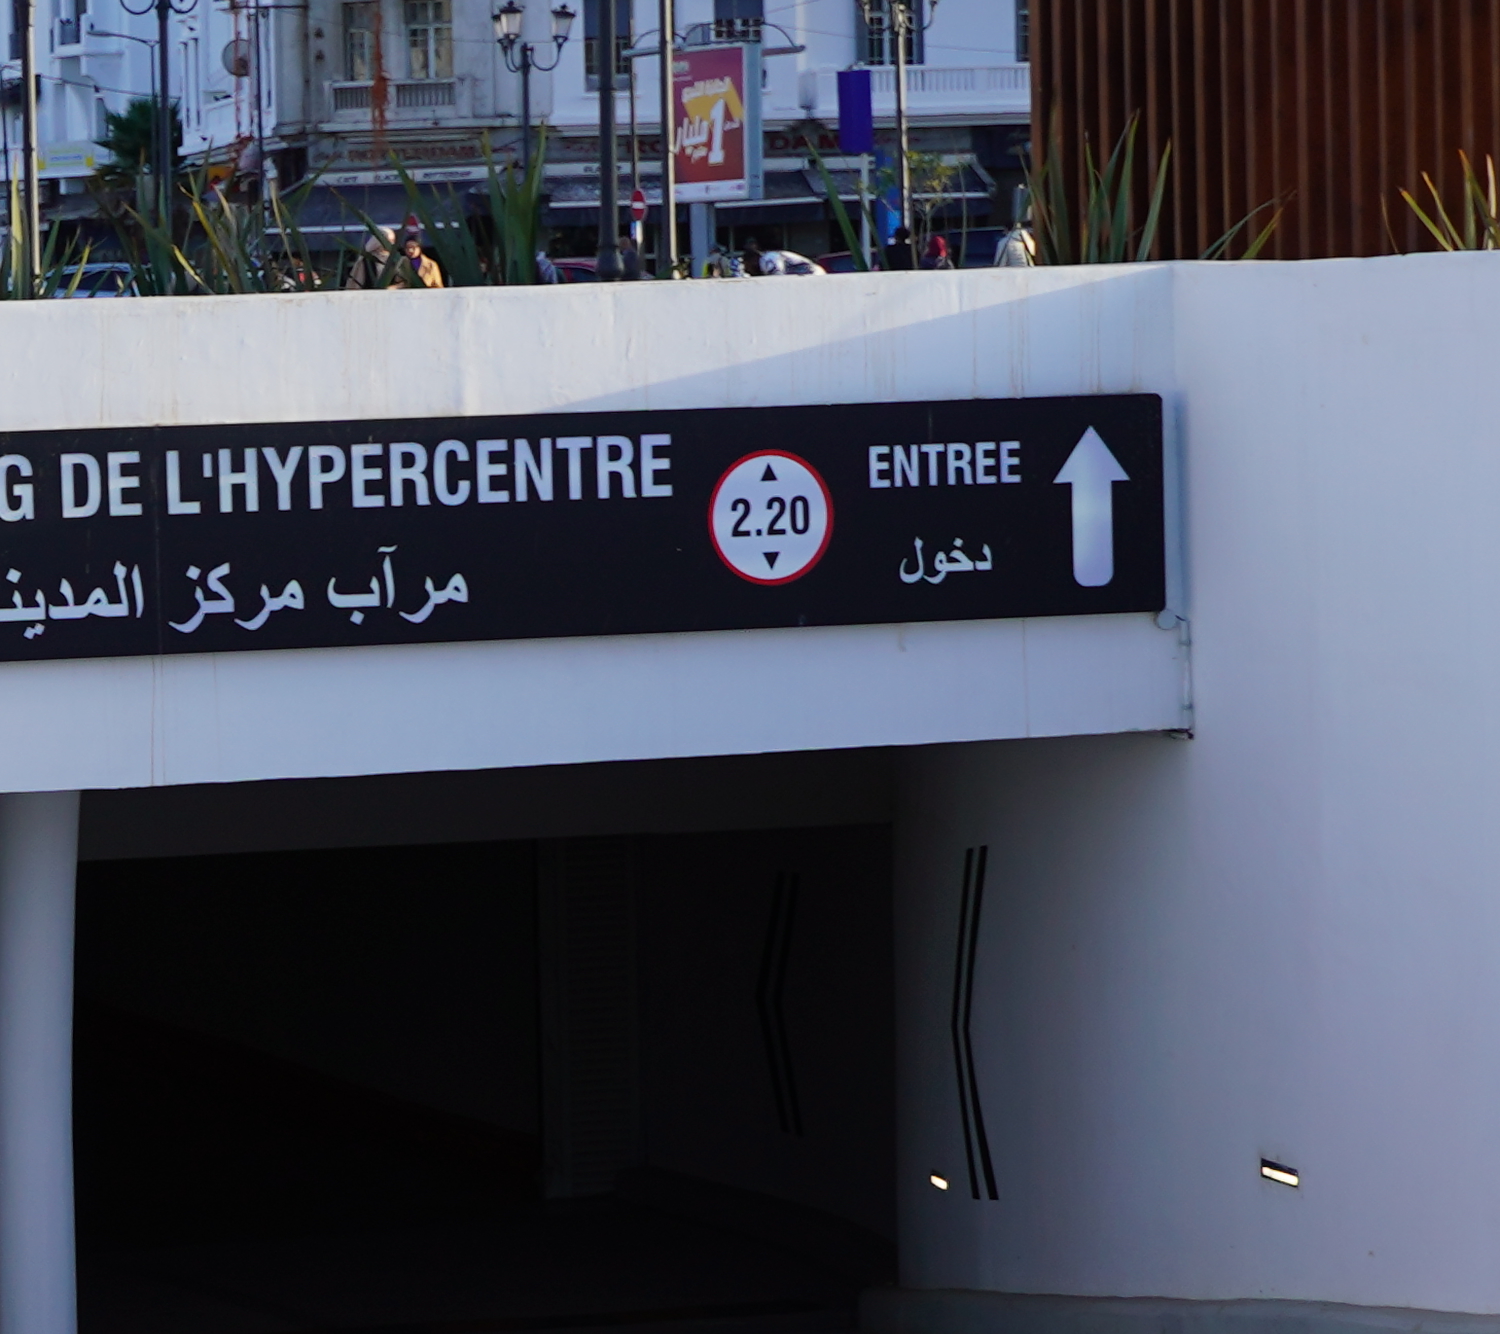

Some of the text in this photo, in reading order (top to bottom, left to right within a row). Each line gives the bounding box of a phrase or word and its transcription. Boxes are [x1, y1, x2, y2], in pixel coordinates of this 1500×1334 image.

[61, 451, 142, 518] DE
[166, 434, 672, 514] L'HYPERCENTRE
[870, 441, 1020, 487] ENTREE
[731, 496, 809, 537] 2.20
[328, 546, 467, 624] مرآب
[900, 538, 991, 583] دخول
[169, 563, 304, 632] مركز
